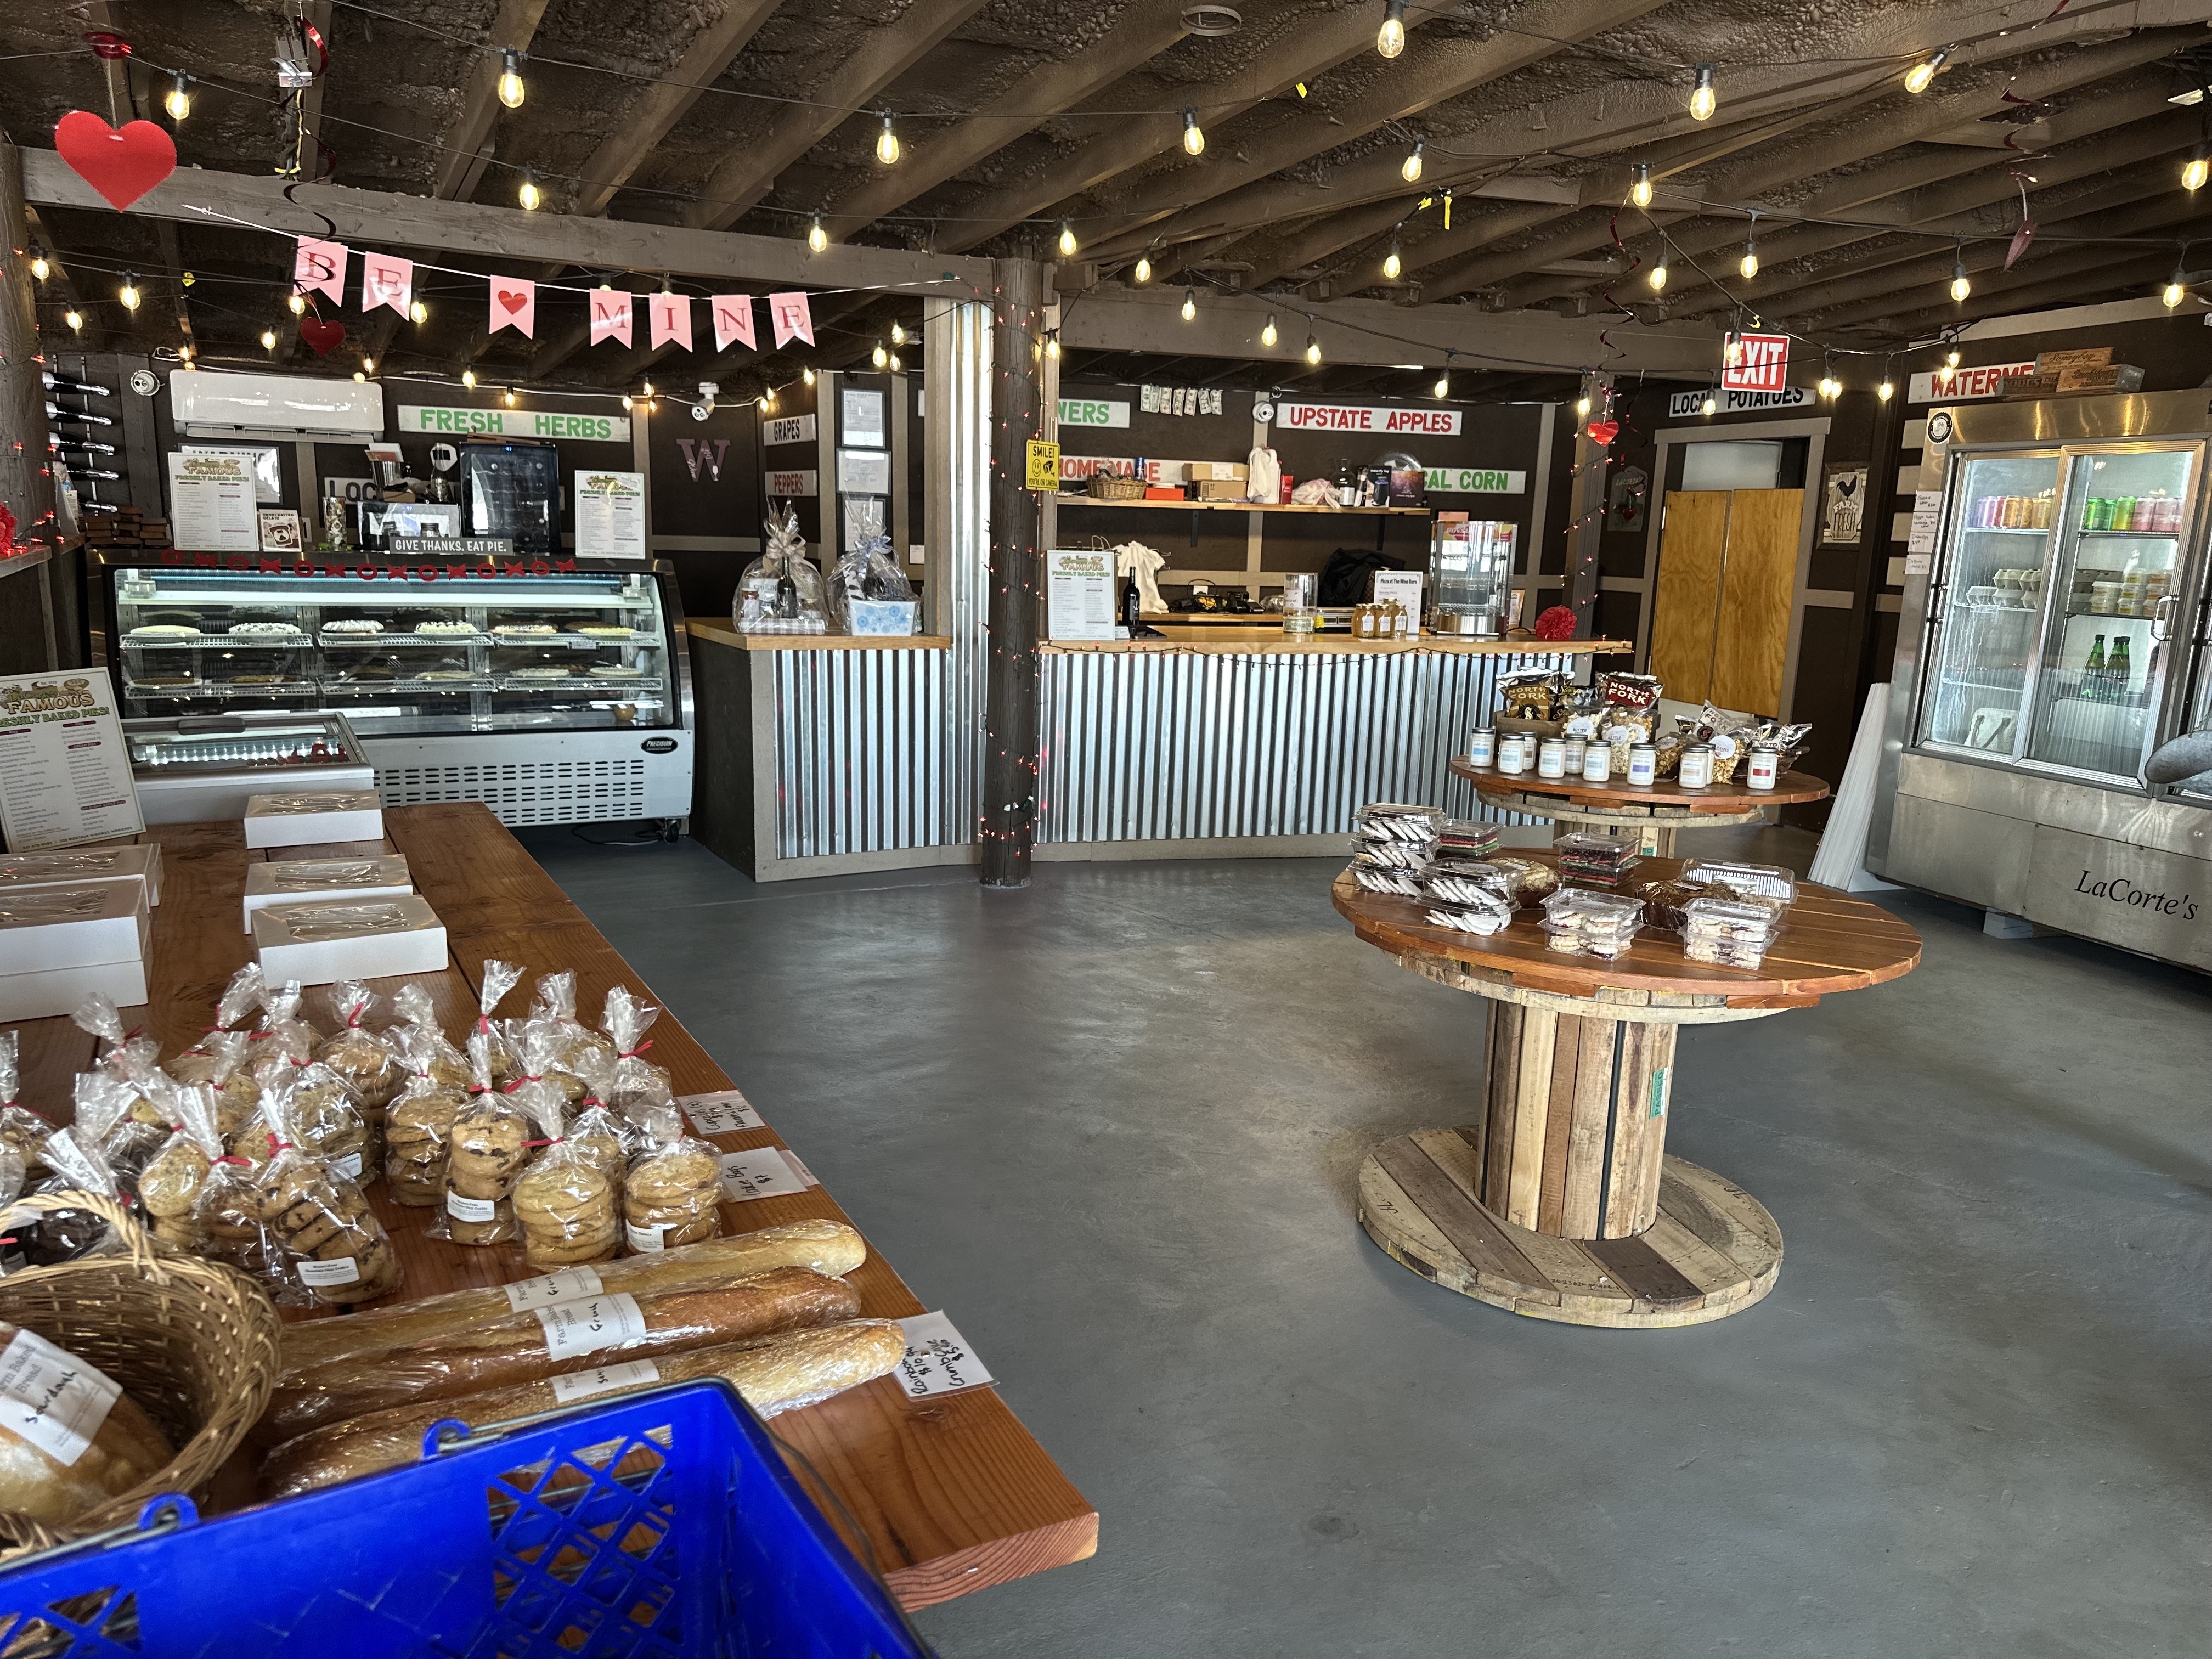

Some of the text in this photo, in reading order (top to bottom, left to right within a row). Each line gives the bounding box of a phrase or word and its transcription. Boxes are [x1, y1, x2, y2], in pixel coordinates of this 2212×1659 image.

[1672, 392, 1707, 415] LOCA
[420, 409, 612, 439] FRESH HERBS
[1290, 407, 1452, 432] UPSTATE APPLES
[774, 419, 800, 442] GRAPES
[1033, 445, 1054, 458] SMILE!
[774, 473, 804, 494] PEPPERS
[1459, 471, 1509, 490] CORN
[1833, 500, 1858, 514] FARM
[1833, 512, 1856, 531] FRESH
[395, 540, 507, 552] GIVE THANKS. EAT PIE.
[1509, 685, 1546, 694] NORTH
[1510, 691, 1547, 700] FORK
[1609, 688, 1646, 704] FORK
[1610, 681, 1649, 699] NORTH
[7, 693, 95, 715] FAMOUS
[42, 710, 81, 723] BAKED
[81, 707, 110, 718] PIES!
[2074, 870, 2198, 921] LaCorte's
[726, 1165, 761, 1197] Cookie Bags
[560, 1308, 577, 1326] Bread
[555, 1319, 567, 1345] Farm
[940, 1357, 965, 1386] Crumb
